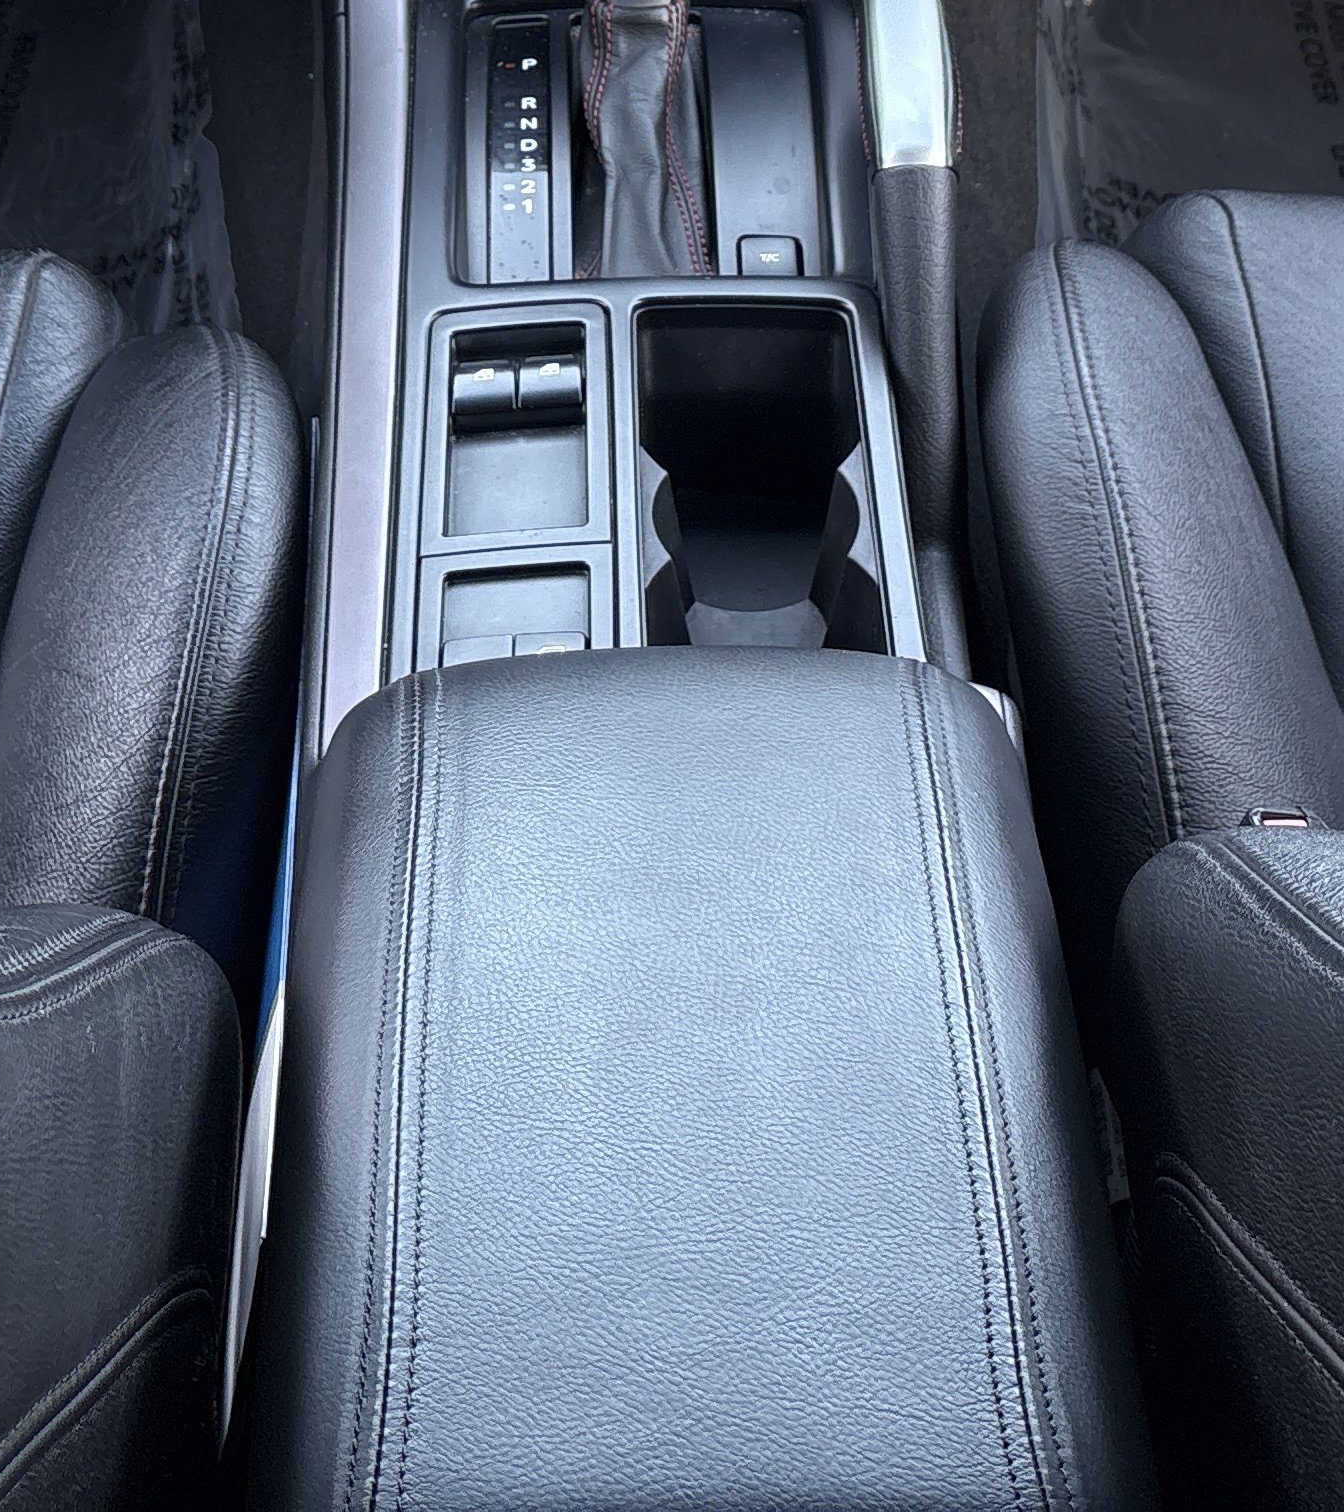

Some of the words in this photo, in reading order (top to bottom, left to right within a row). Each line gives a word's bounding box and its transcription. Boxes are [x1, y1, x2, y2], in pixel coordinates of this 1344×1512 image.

[521, 58, 538, 71] P
[520, 96, 538, 110] R
[520, 117, 538, 130] N
[520, 138, 538, 152] D
[520, 159, 537, 173] 3
[520, 180, 537, 194] 2
[521, 200, 534, 214] 1
[759, 252, 781, 264] T/C
